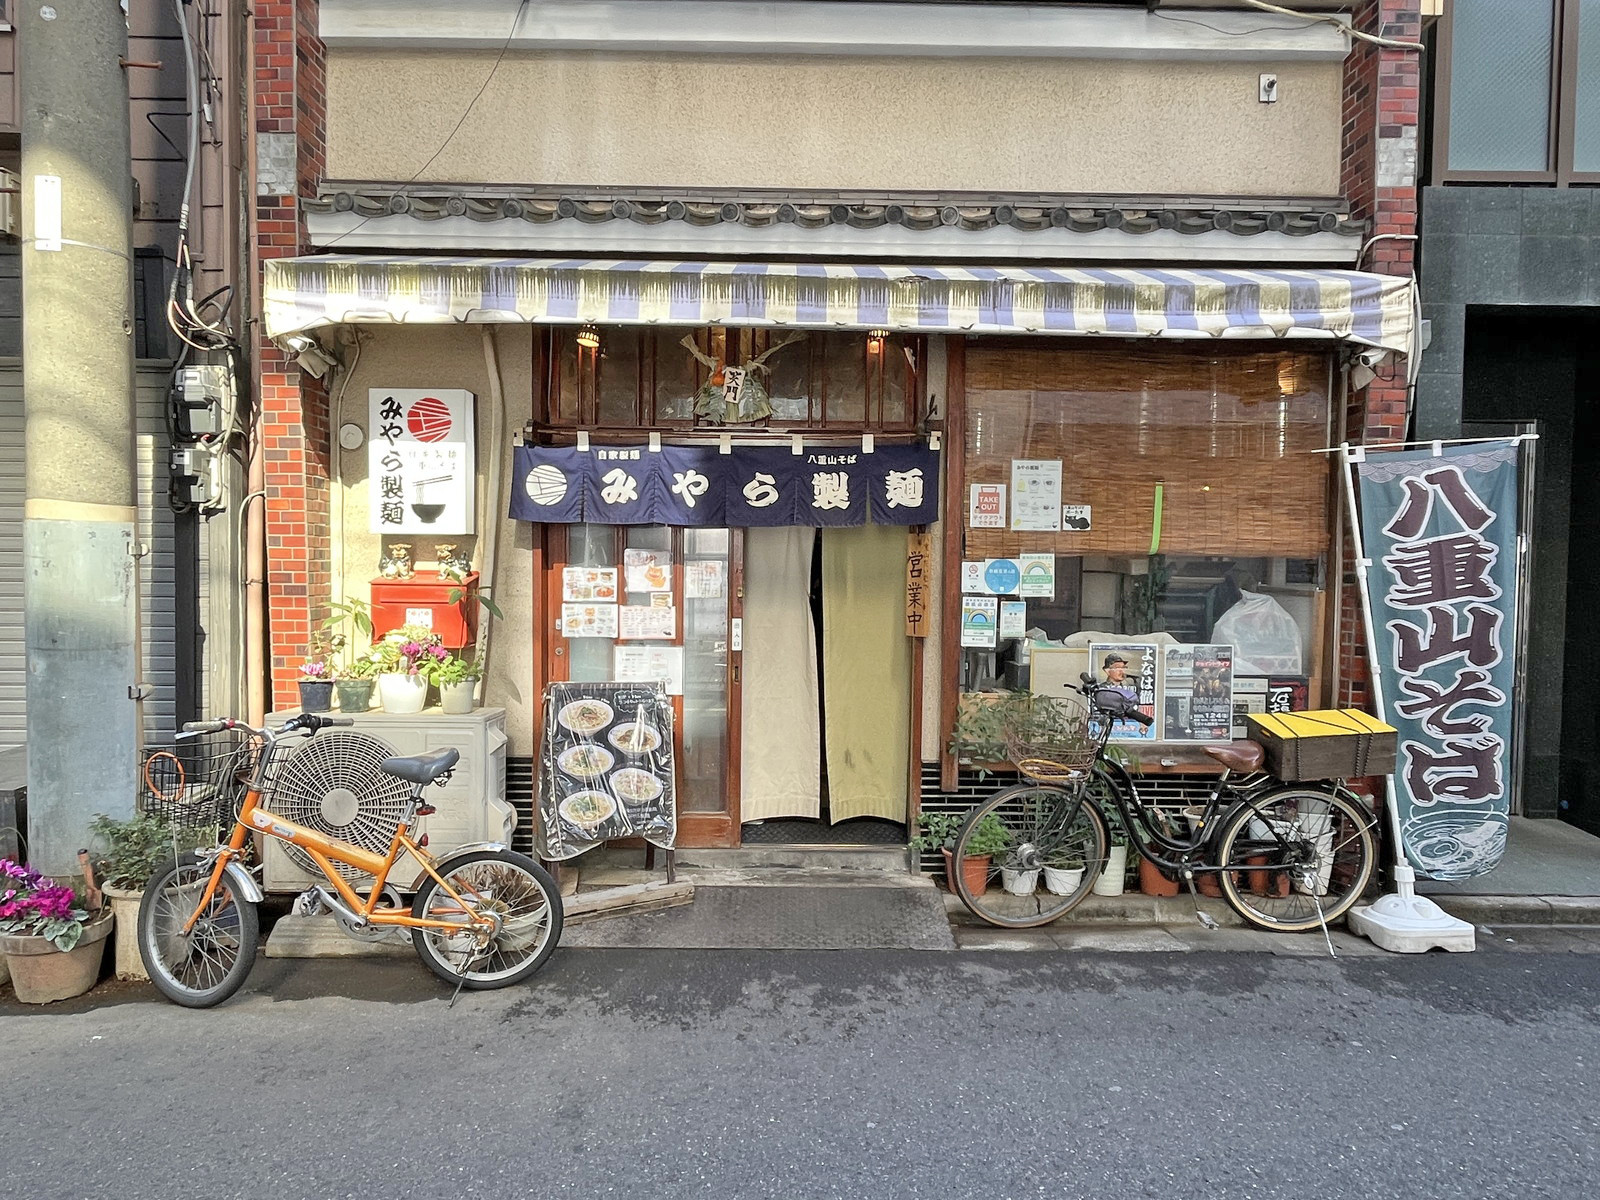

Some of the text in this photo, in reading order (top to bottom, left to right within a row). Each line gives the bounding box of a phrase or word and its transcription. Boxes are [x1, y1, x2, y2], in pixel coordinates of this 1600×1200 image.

[724, 371, 742, 401] 笑門
[380, 396, 404, 525] みやら製麺
[600, 467, 925, 510] みやら製麺
[807, 454, 858, 465] 八重山そば
[908, 551, 923, 635] 営業中
[1382, 465, 1506, 806] 八重山そば
[1140, 646, 1154, 704] よなは徹
